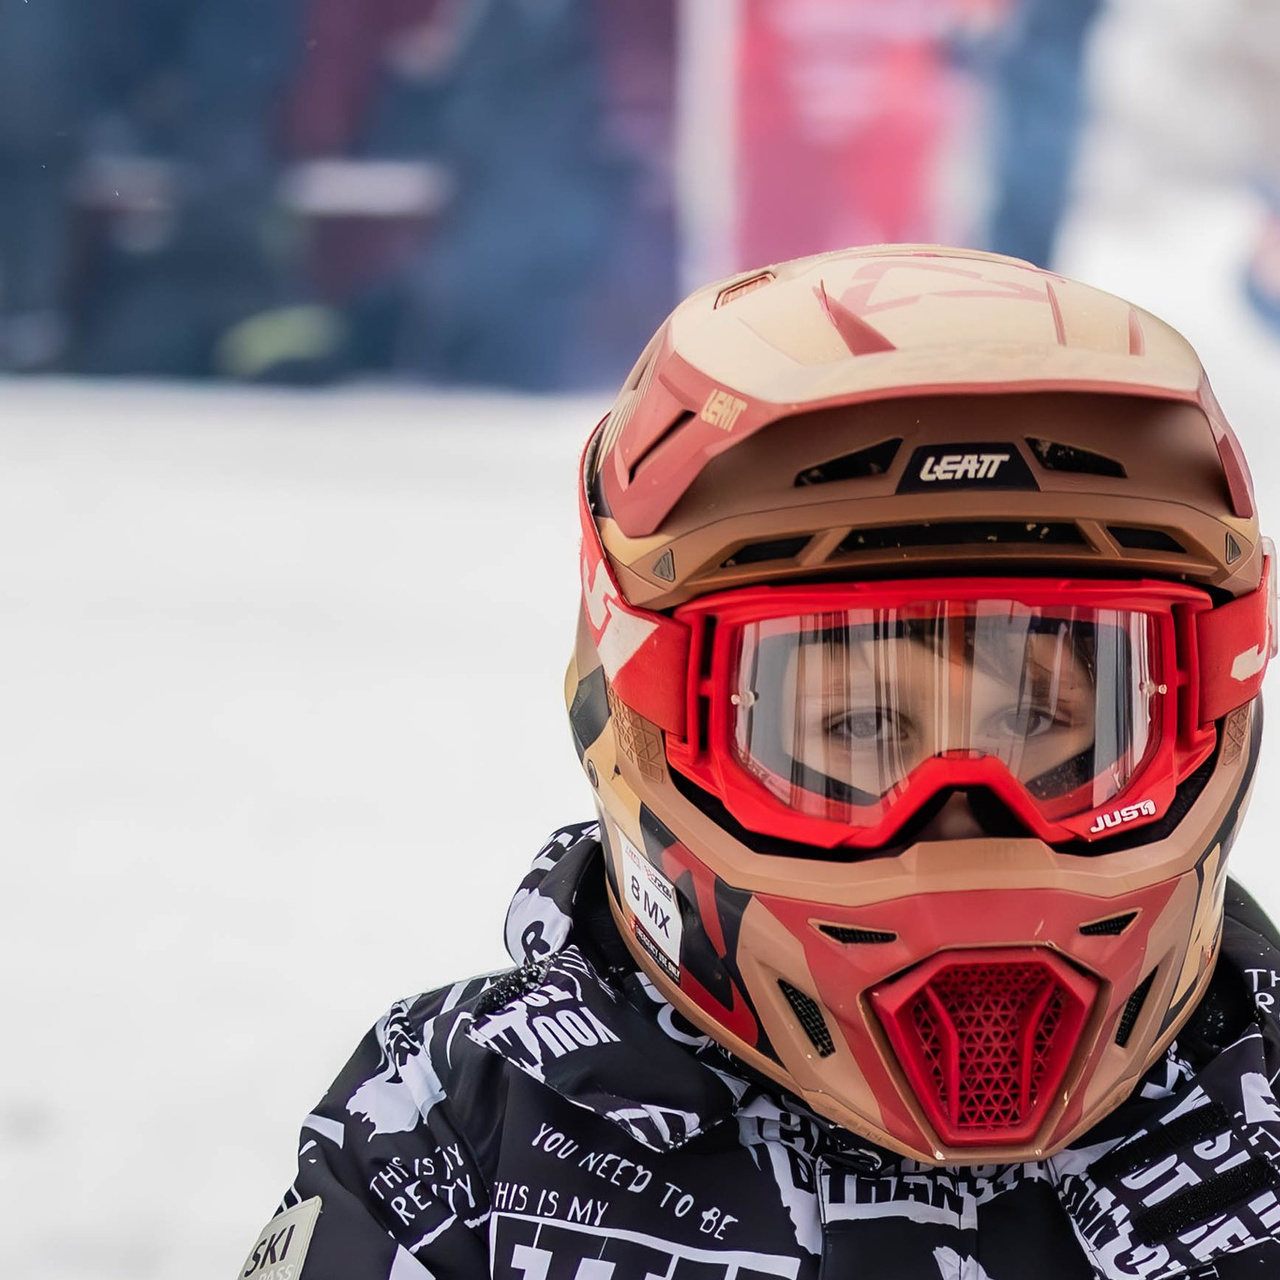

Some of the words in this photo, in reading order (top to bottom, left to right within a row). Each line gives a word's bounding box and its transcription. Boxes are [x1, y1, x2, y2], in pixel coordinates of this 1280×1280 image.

[920, 454, 1010, 481] LEATT
[631, 875, 641, 902] 8
[643, 890, 671, 939] MX
[532, 1122, 579, 1160] YOU
[579, 1152, 652, 1194] NEED
[659, 1181, 695, 1218] TO
[700, 1207, 739, 1240] BE
[536, 1189, 560, 1217] IS
[567, 1196, 609, 1227] MY
[244, 1224, 296, 1278] SKI
